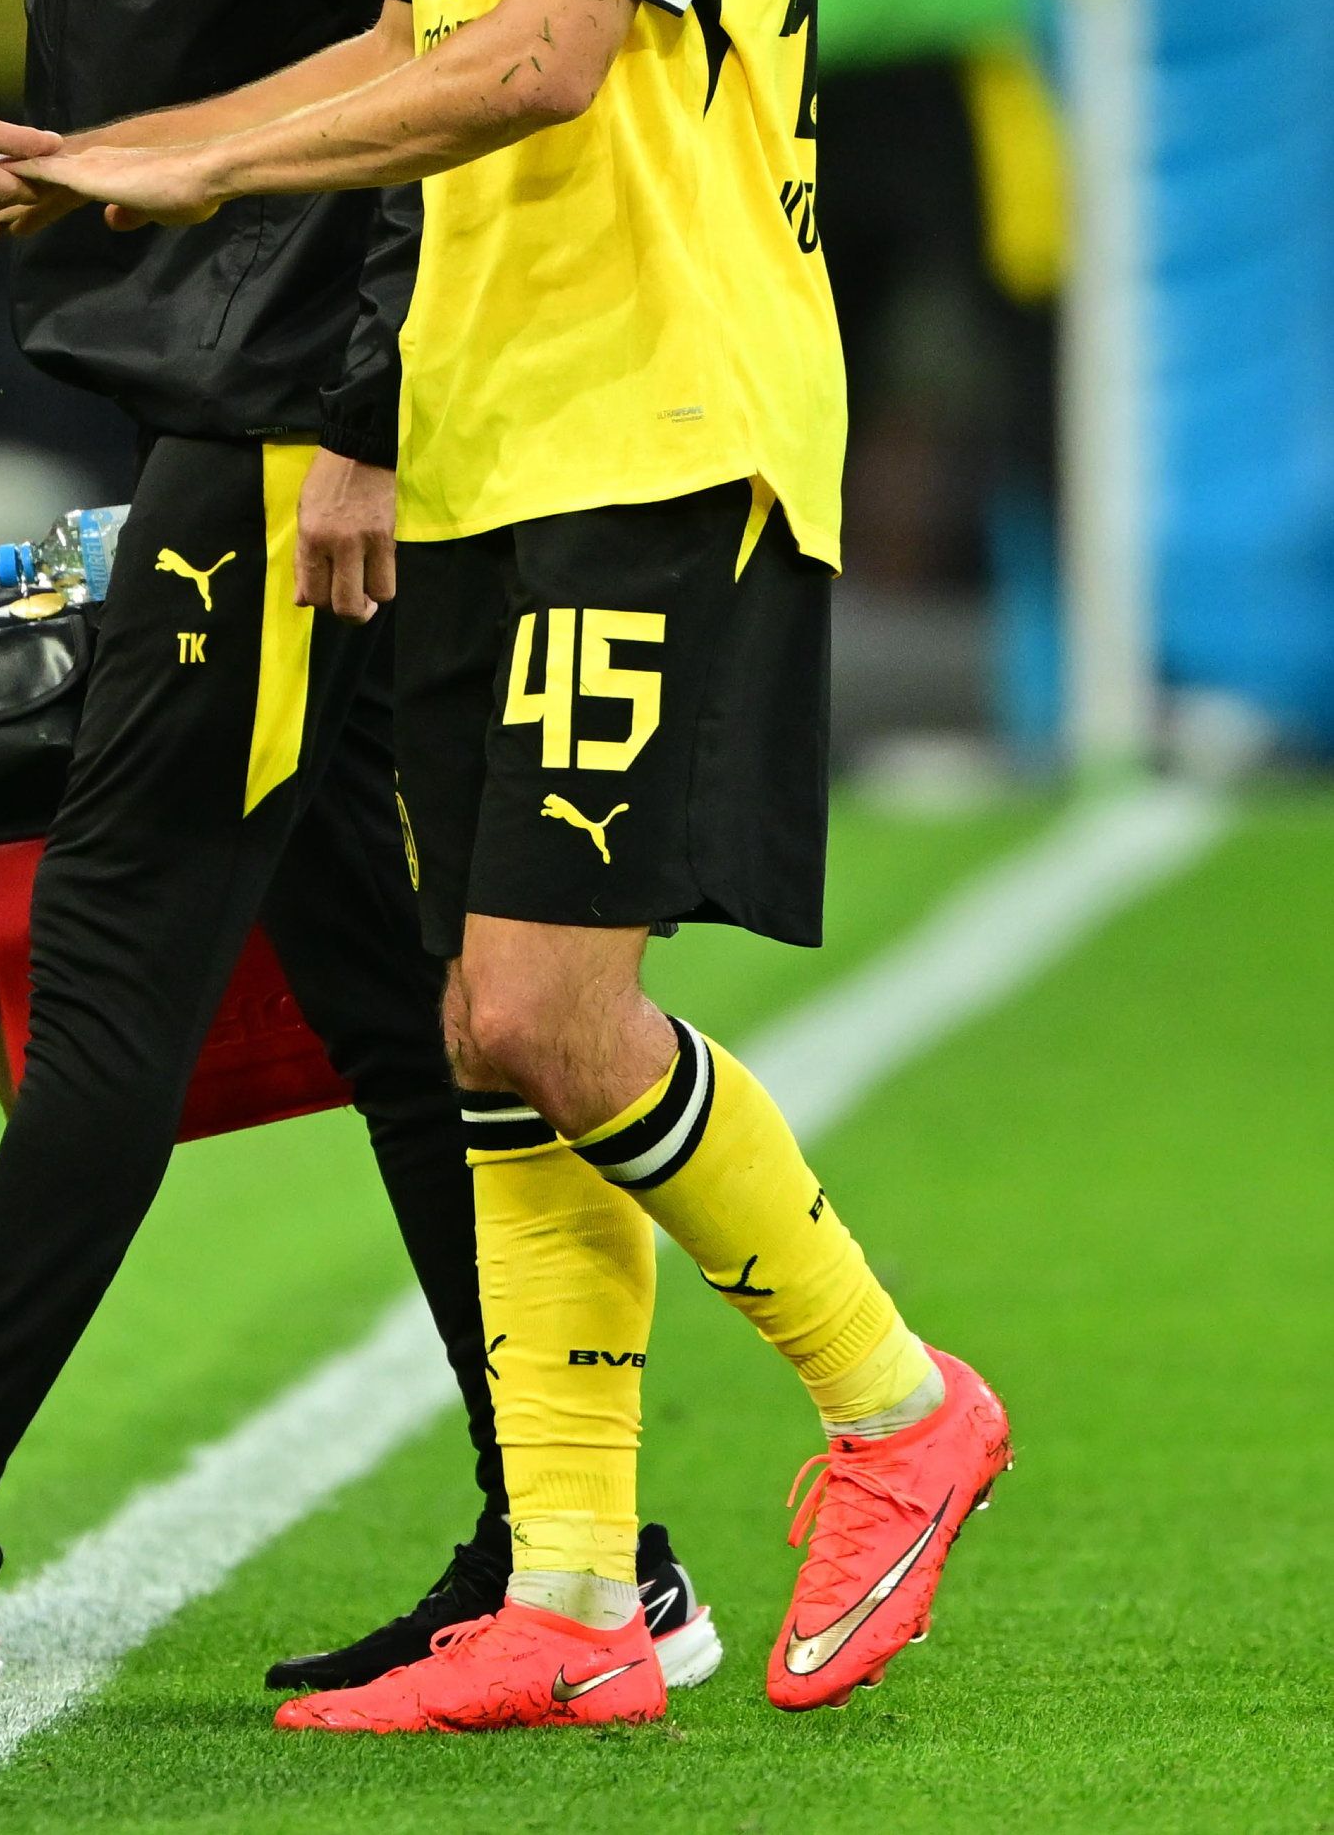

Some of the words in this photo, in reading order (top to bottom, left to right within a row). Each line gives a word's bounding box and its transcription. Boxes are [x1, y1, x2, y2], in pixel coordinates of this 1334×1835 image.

[177, 632, 207, 664] TK
[502, 608, 667, 771] 45
[568, 1350, 646, 1368] BVB
